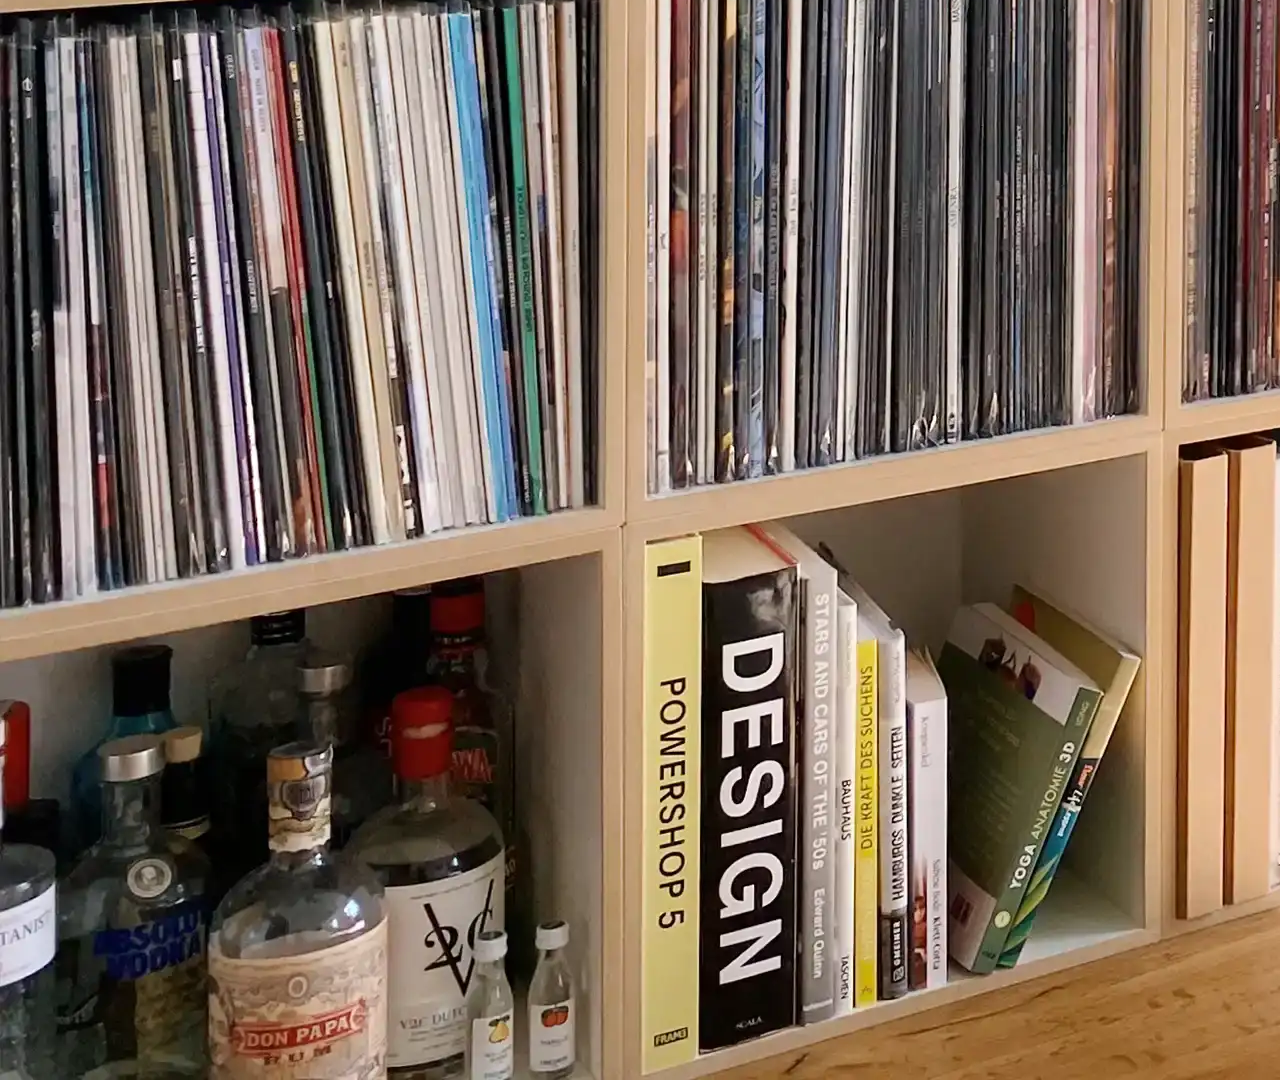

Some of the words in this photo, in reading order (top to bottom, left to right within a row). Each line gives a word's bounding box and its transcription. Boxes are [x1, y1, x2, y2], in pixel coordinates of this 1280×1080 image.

[812, 593, 830, 656] STARS
[812, 660, 830, 700] AND
[860, 665, 874, 736] SUCHENS
[812, 703, 829, 754] CARS
[890, 727, 905, 768] SEITEN
[811, 759, 828, 785] OF
[860, 740, 874, 769] DES
[658, 677, 687, 898] POWERSHOP
[718, 631, 786, 986] DESIGN
[811, 789, 828, 828] THE
[840, 778, 853, 842] BAUHAUS
[860, 775, 874, 821] KRAFT
[890, 776, 905, 824] DUNKLE
[860, 823, 874, 850] DIE
[1008, 845, 1036, 891] YOGA
[1030, 765, 1063, 842] ANATOMIE
[1058, 740, 1077, 765] 3D
[810, 831, 828, 870] '50s
[890, 830, 905, 901] HAMBURGS
[659, 910, 686, 930] 5
[811, 888, 826, 938] Edward
[106, 931, 201, 981] VODKA
[811, 939, 826, 980] Quinn
[892, 921, 902, 966] GMEINER
[932, 916, 943, 971] Klett-Cotta
[840, 954, 850, 1001] TASCHEN
[245, 1025, 289, 1048] DON
[295, 1017, 349, 1045] PAPA
[263, 1044, 332, 1066] RUM
